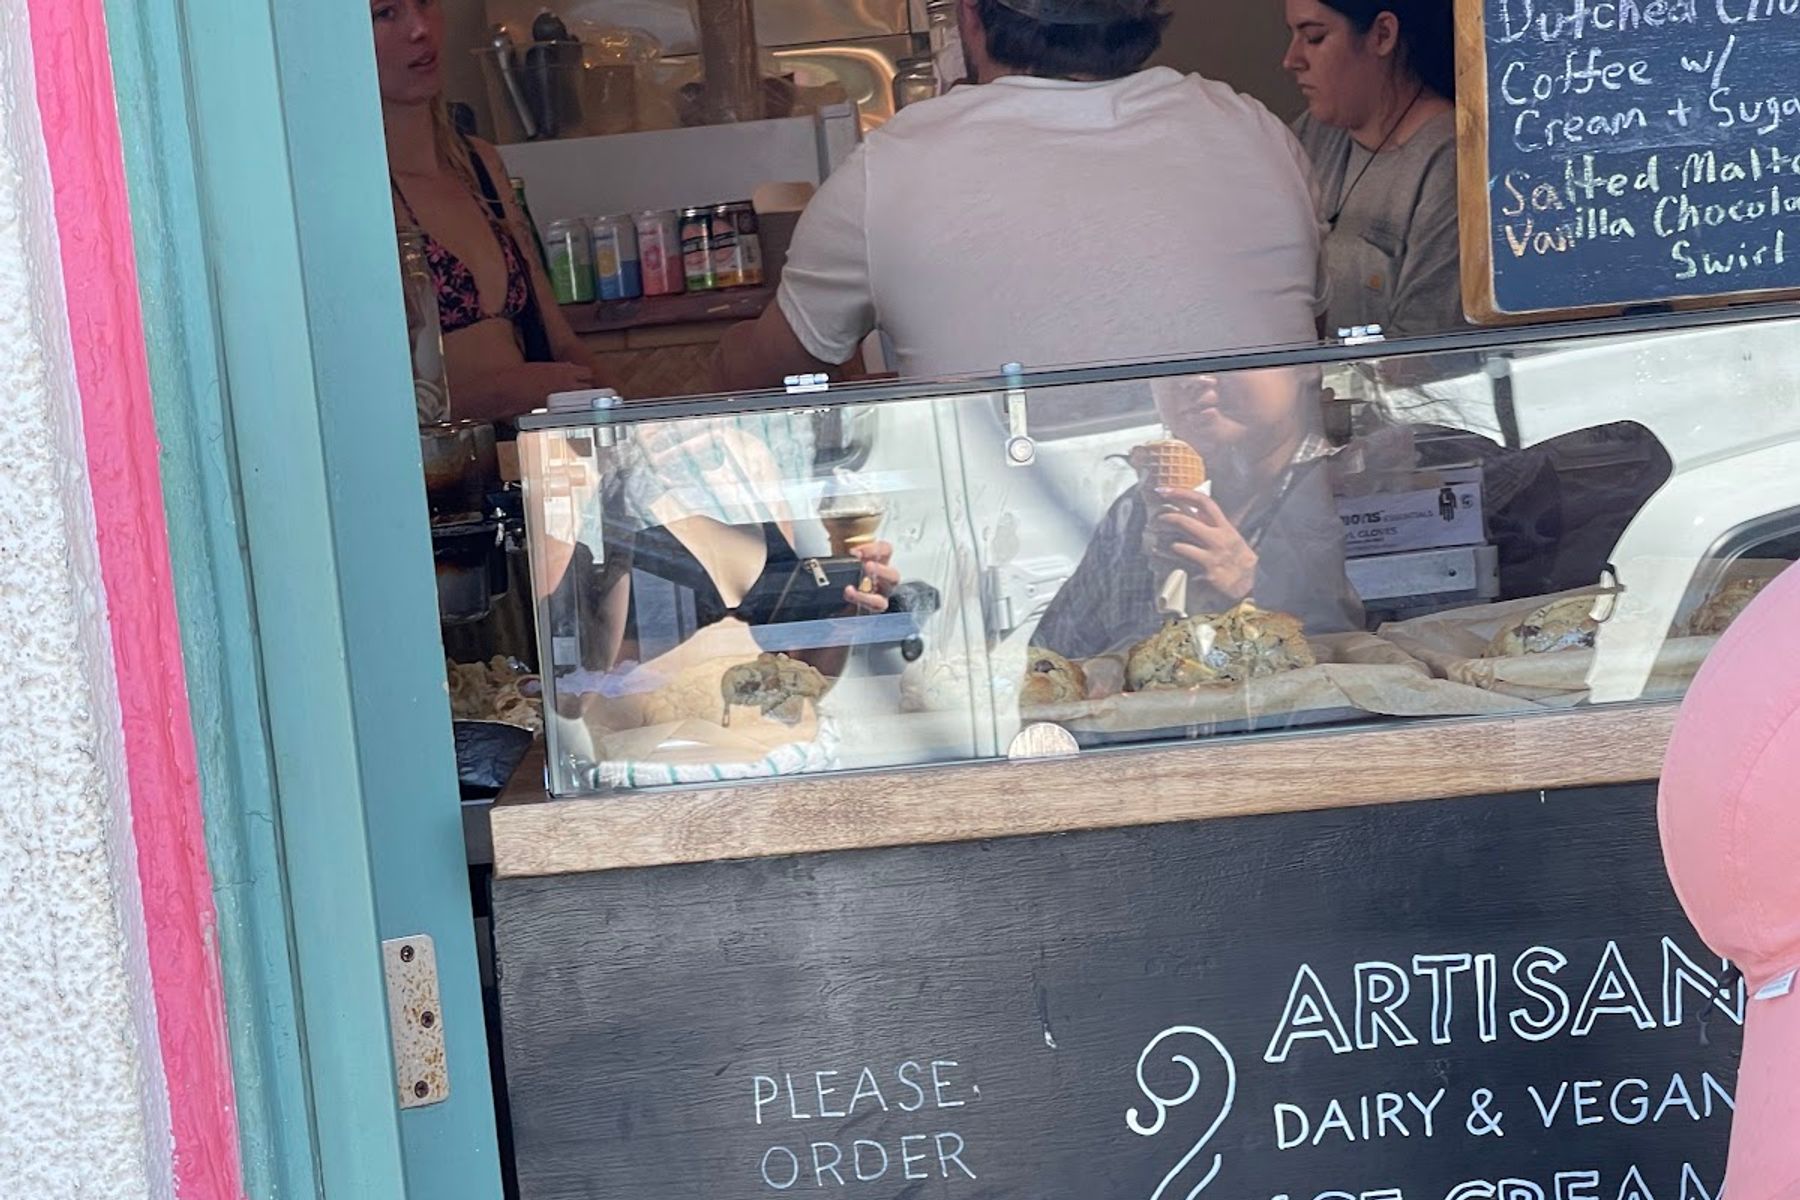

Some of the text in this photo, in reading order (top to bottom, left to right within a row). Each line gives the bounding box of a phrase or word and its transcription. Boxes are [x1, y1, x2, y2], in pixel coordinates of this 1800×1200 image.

[1502, 35, 1735, 105] Coffee w/
[1513, 108, 1647, 152] Cream
[1502, 155, 1660, 216] Salted
[1671, 230, 1785, 279] Swirl
[1264, 936, 1746, 1062] ARTISAN
[754, 1060, 965, 1124] PLEASE
[1273, 1088, 1446, 1150] DAIRY
[1466, 1087, 1505, 1137] &
[761, 1132, 977, 1189] ORDER
